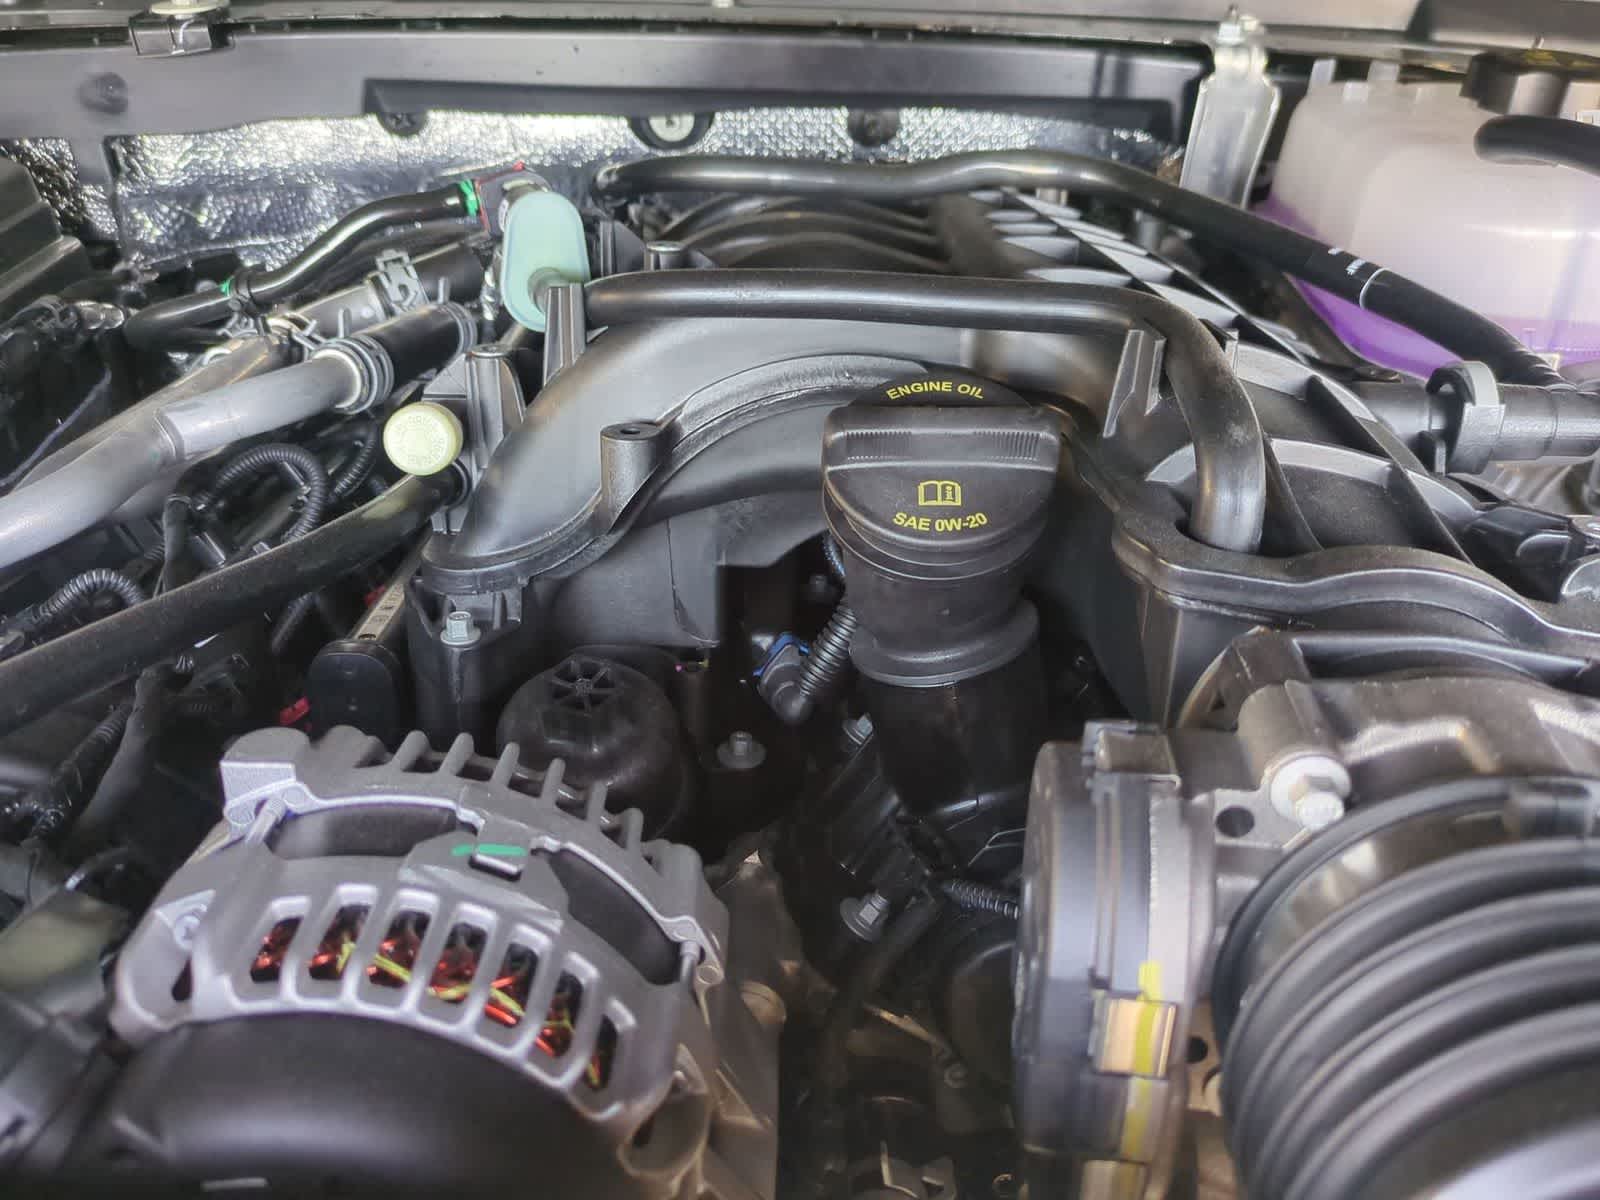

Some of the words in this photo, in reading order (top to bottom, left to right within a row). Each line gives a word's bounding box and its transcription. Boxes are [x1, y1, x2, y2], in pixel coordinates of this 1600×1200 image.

[886, 381, 952, 400] ENGINE
[957, 383, 984, 399] OIL
[893, 512, 931, 531] SAE
[935, 512, 988, 532] 0W-20
